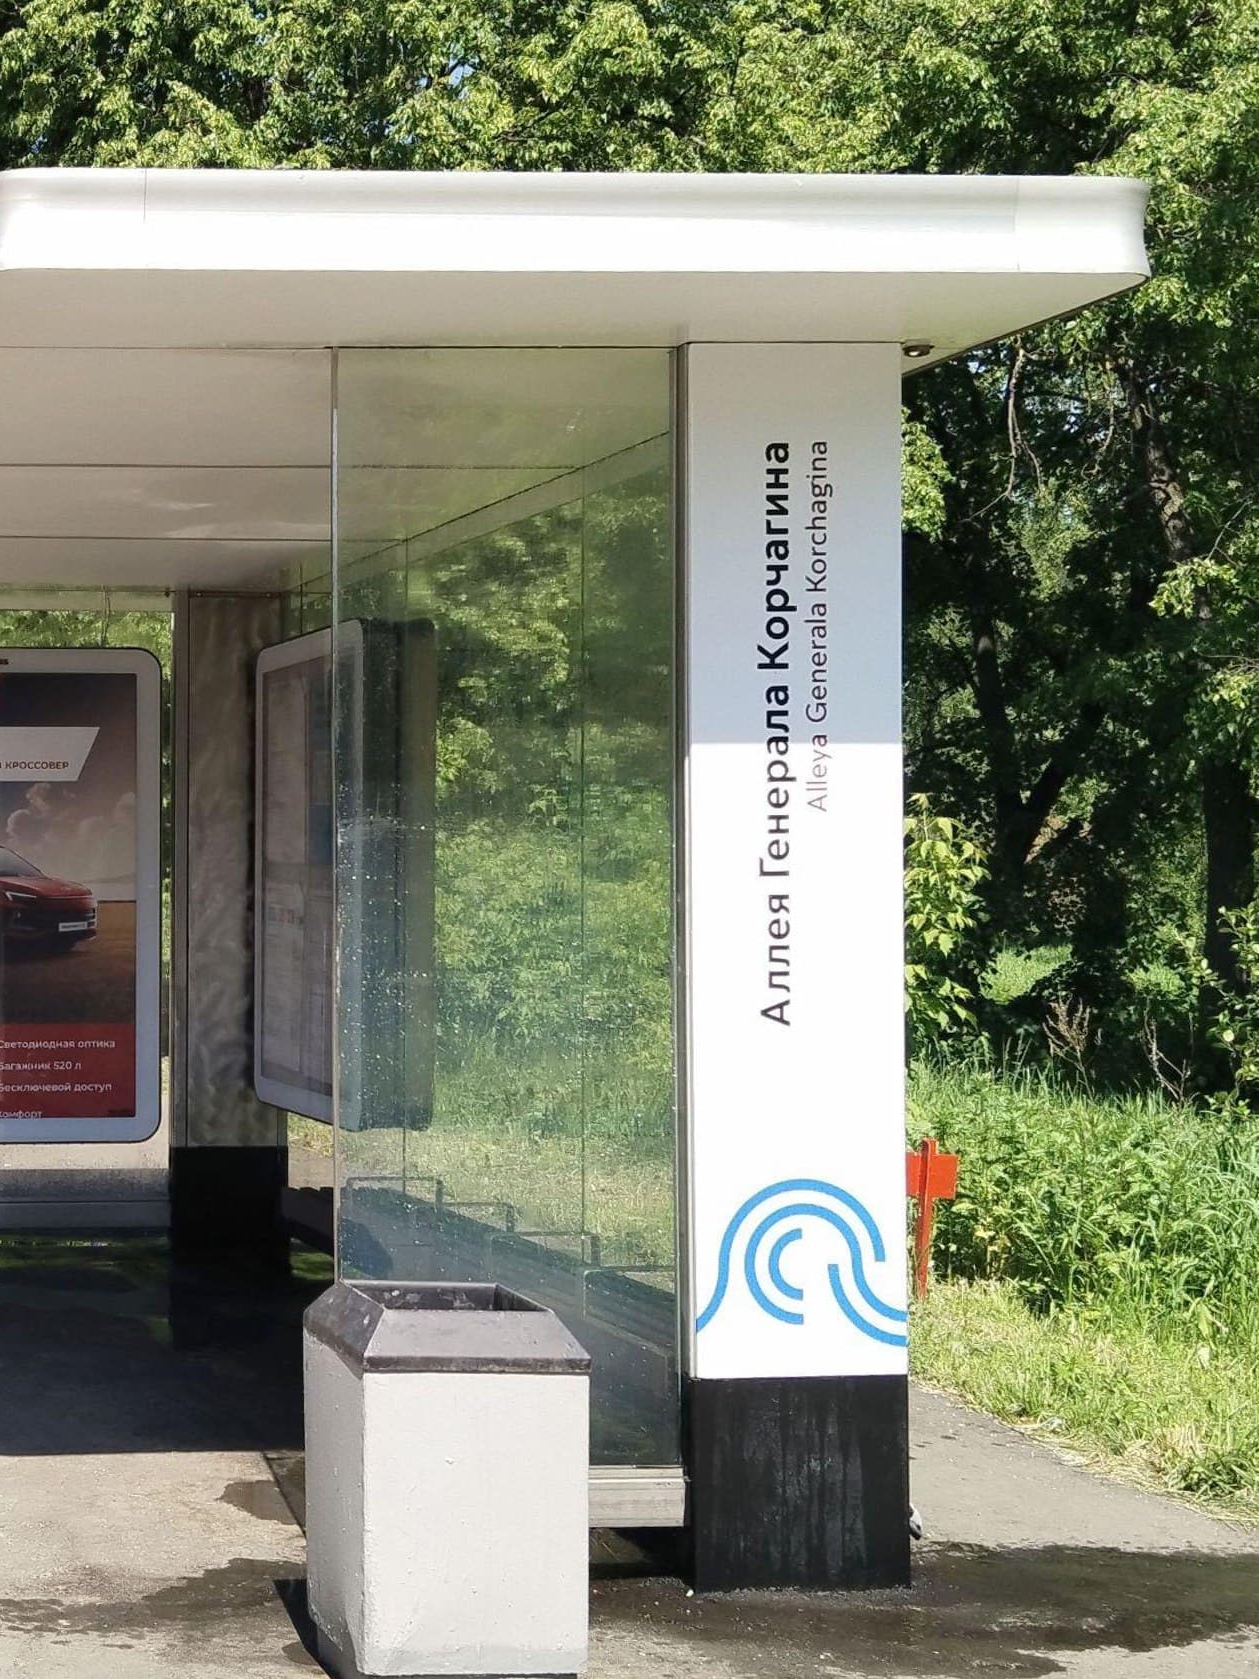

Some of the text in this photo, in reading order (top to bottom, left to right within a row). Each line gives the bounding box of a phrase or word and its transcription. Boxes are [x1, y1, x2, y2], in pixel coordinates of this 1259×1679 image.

[804, 440, 834, 813] Alleya Generala Korchagina
[756, 441, 798, 1027] Аллея Генерала Корчагина
[5, 760, 70, 770] КРОССОВЕР
[77, 1040, 116, 1049] оптика
[53, 1061, 72, 1070] 520
[74, 1083, 112, 1094] доступ
